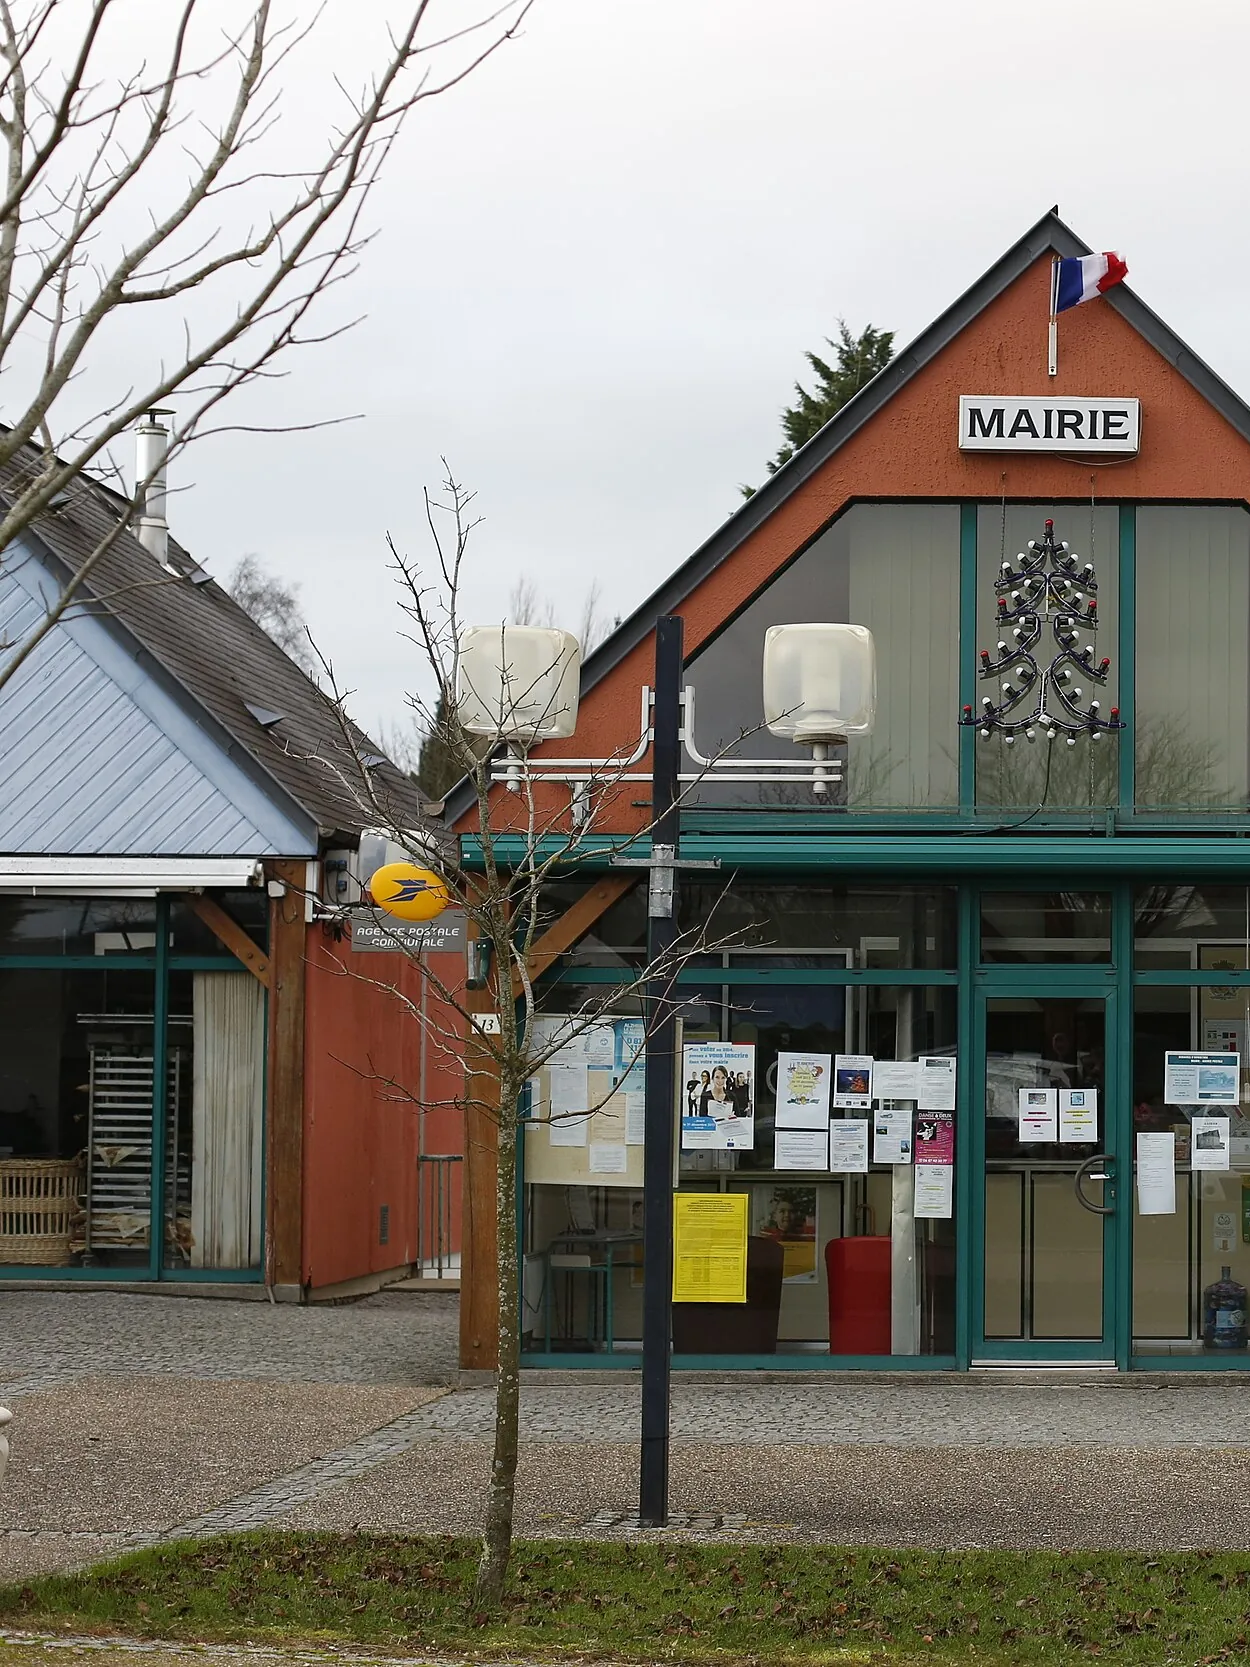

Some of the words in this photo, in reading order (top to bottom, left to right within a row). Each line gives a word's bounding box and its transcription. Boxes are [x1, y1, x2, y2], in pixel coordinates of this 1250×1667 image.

[967, 407, 1130, 440] MAIRIE
[408, 927, 460, 936] POSTALE
[481, 1019, 494, 1031] 13
